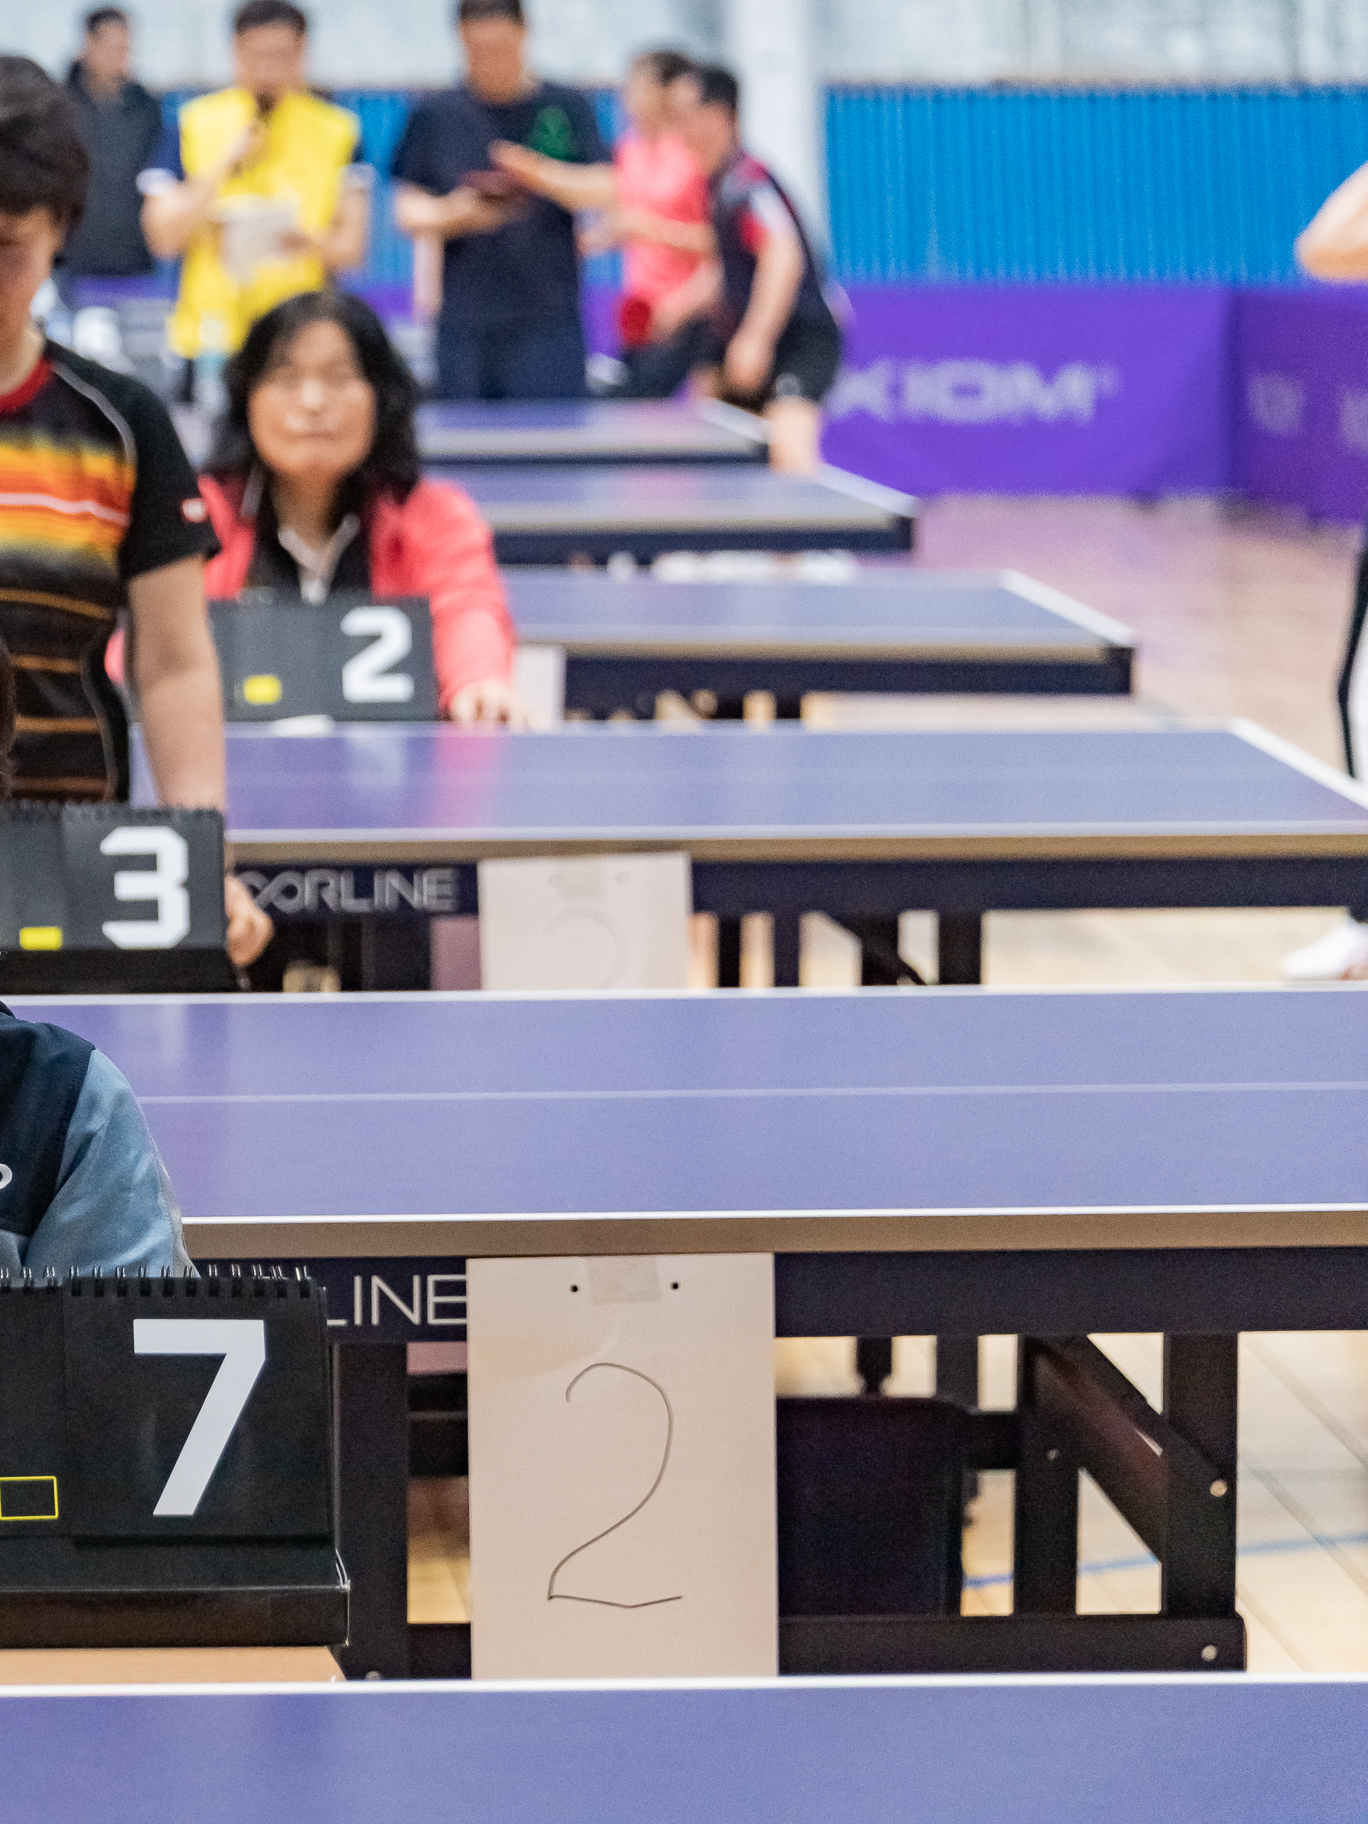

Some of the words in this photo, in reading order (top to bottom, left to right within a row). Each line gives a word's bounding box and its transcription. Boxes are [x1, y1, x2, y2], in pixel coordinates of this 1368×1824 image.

[340, 606, 414, 703] 2
[100, 826, 190, 950] 3
[133, 1318, 267, 1517] 7
[547, 1361, 684, 1610] 2
